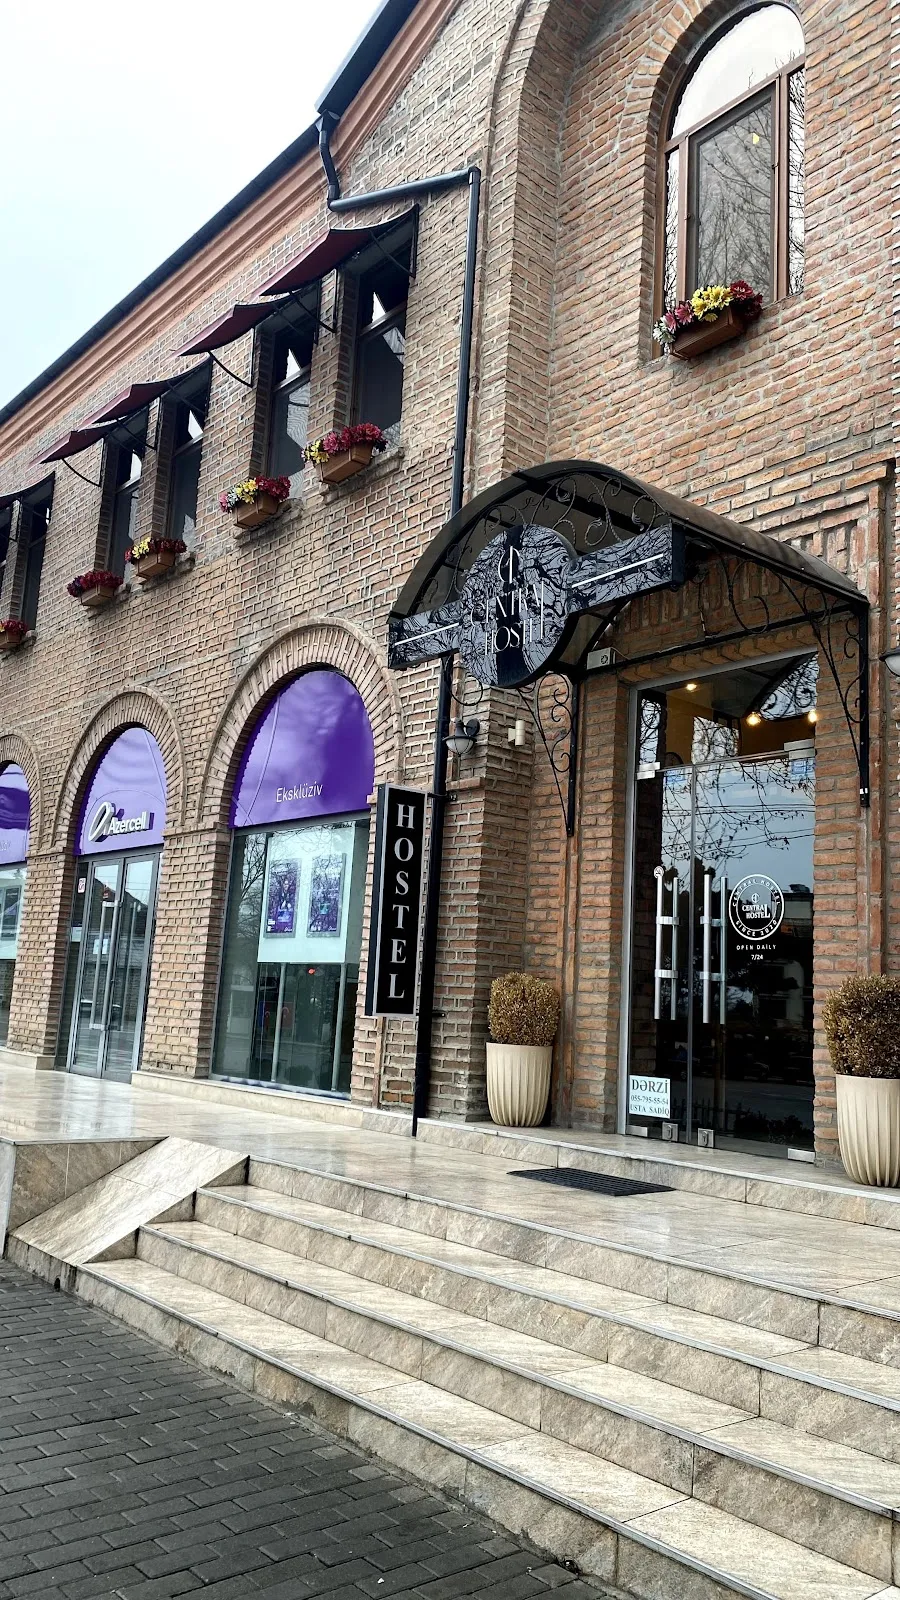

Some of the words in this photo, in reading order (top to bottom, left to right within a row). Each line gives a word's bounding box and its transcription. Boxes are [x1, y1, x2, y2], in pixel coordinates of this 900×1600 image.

[276, 781, 323, 803] Eksklüziv
[108, 811, 149, 835] Azercell
[387, 803, 416, 999] HOSTEL
[631, 1079, 668, 1093] DƏRZİ
[630, 1104, 646, 1112] USTA
